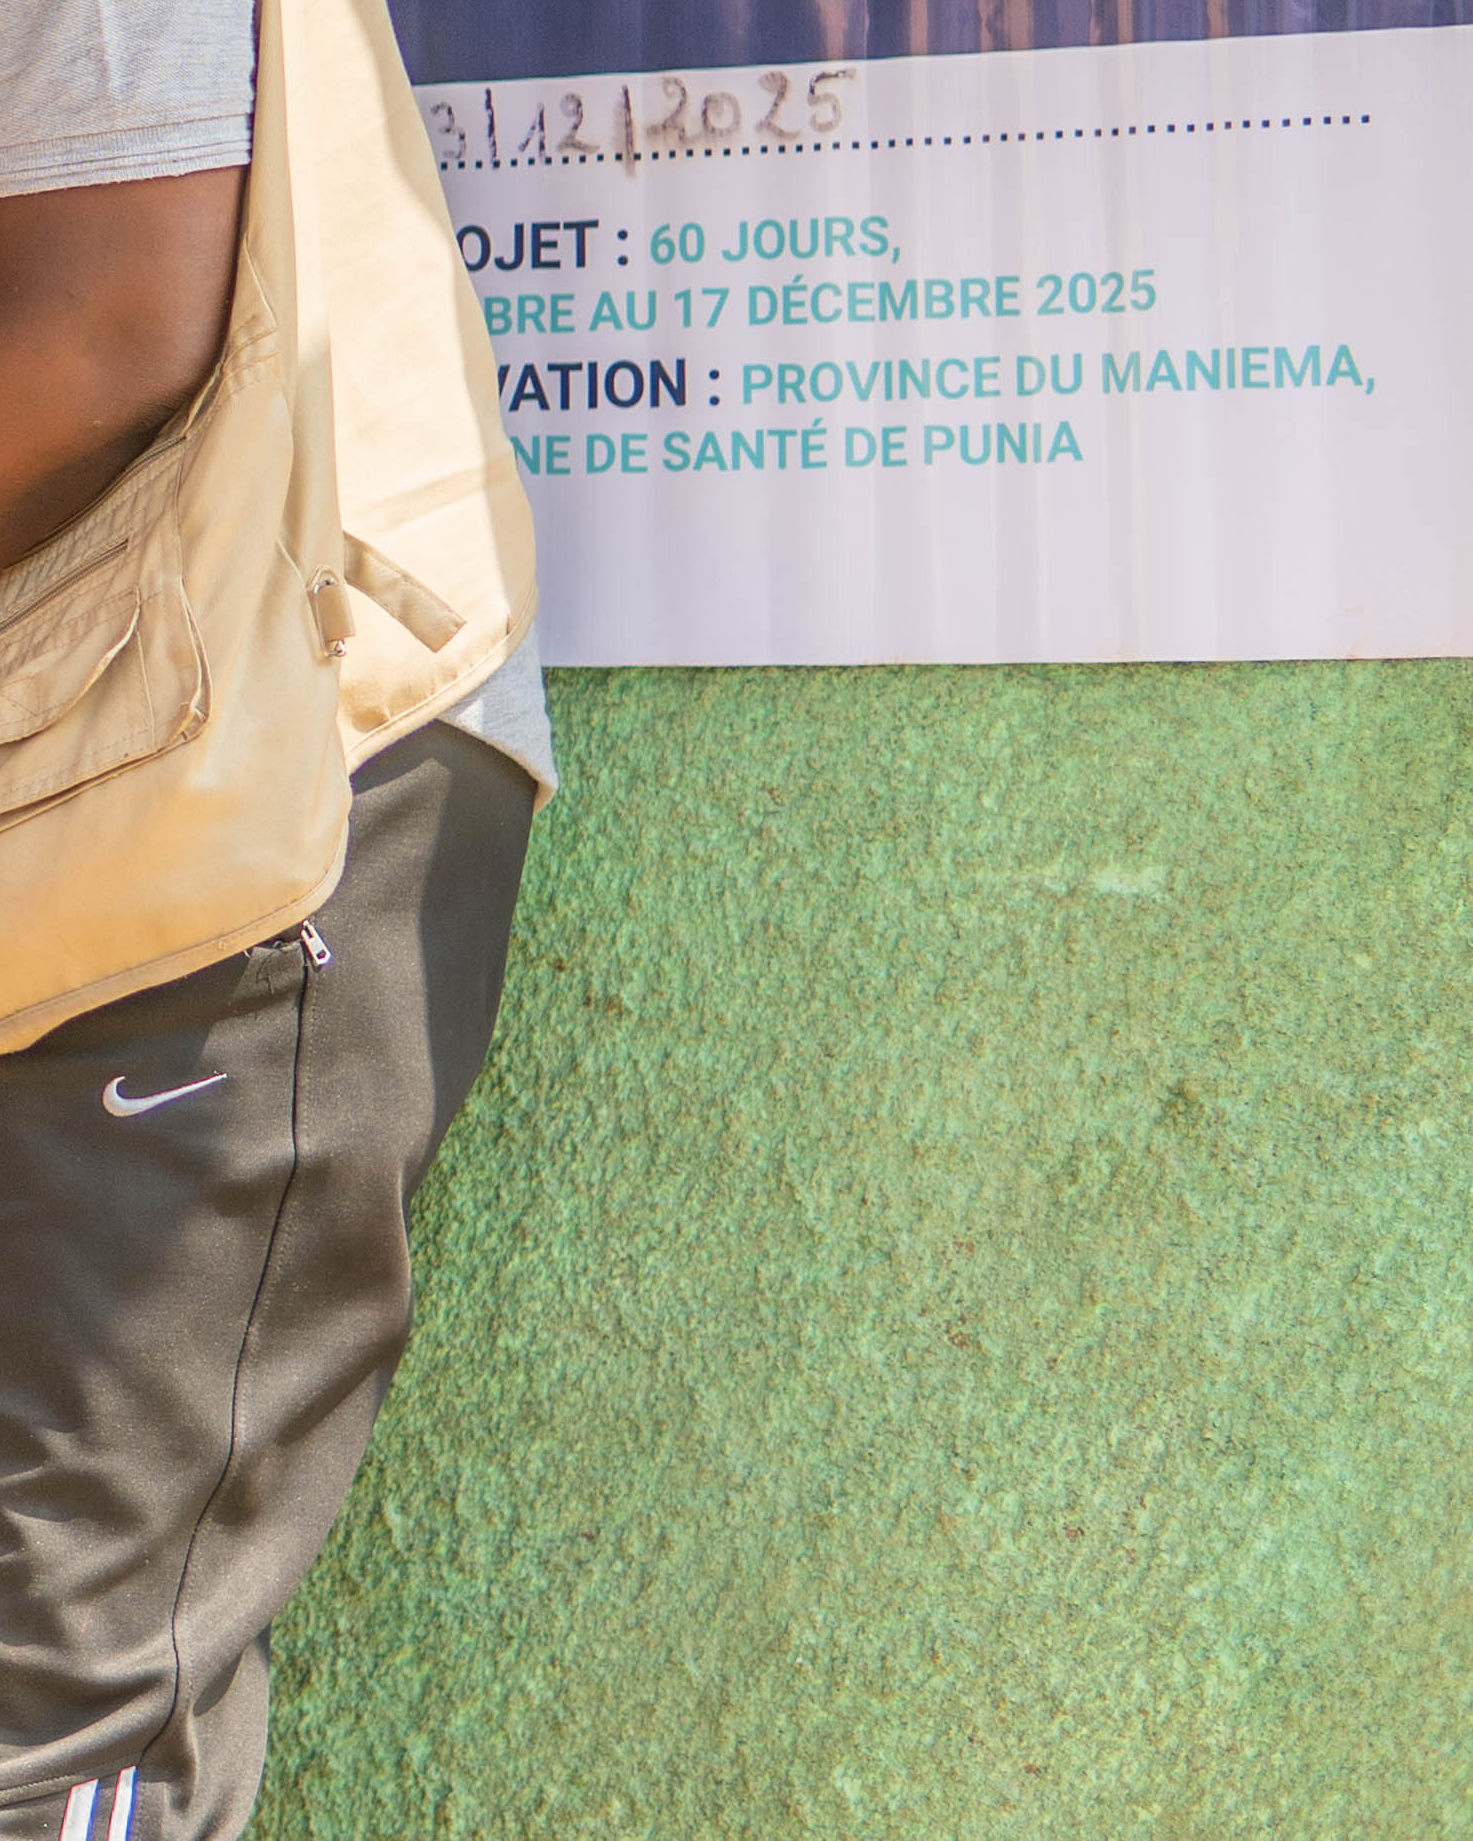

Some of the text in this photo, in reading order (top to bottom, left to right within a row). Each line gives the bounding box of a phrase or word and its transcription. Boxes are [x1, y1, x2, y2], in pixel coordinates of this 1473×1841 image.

[650, 222, 706, 265] 60
[721, 214, 902, 264] JOURS,
[588, 289, 658, 332] AU
[674, 287, 730, 329] 17
[747, 273, 1022, 327] DÉCEMBRE
[1035, 268, 1158, 317] 2025
[742, 356, 1002, 405] PROVINCE
[1016, 351, 1084, 397] DU
[1101, 343, 1377, 398] MANIEMA,
[585, 433, 649, 475] DE
[661, 417, 827, 473] SANTÉ
[845, 425, 907, 469] DE
[923, 419, 1084, 464] PUNIA
